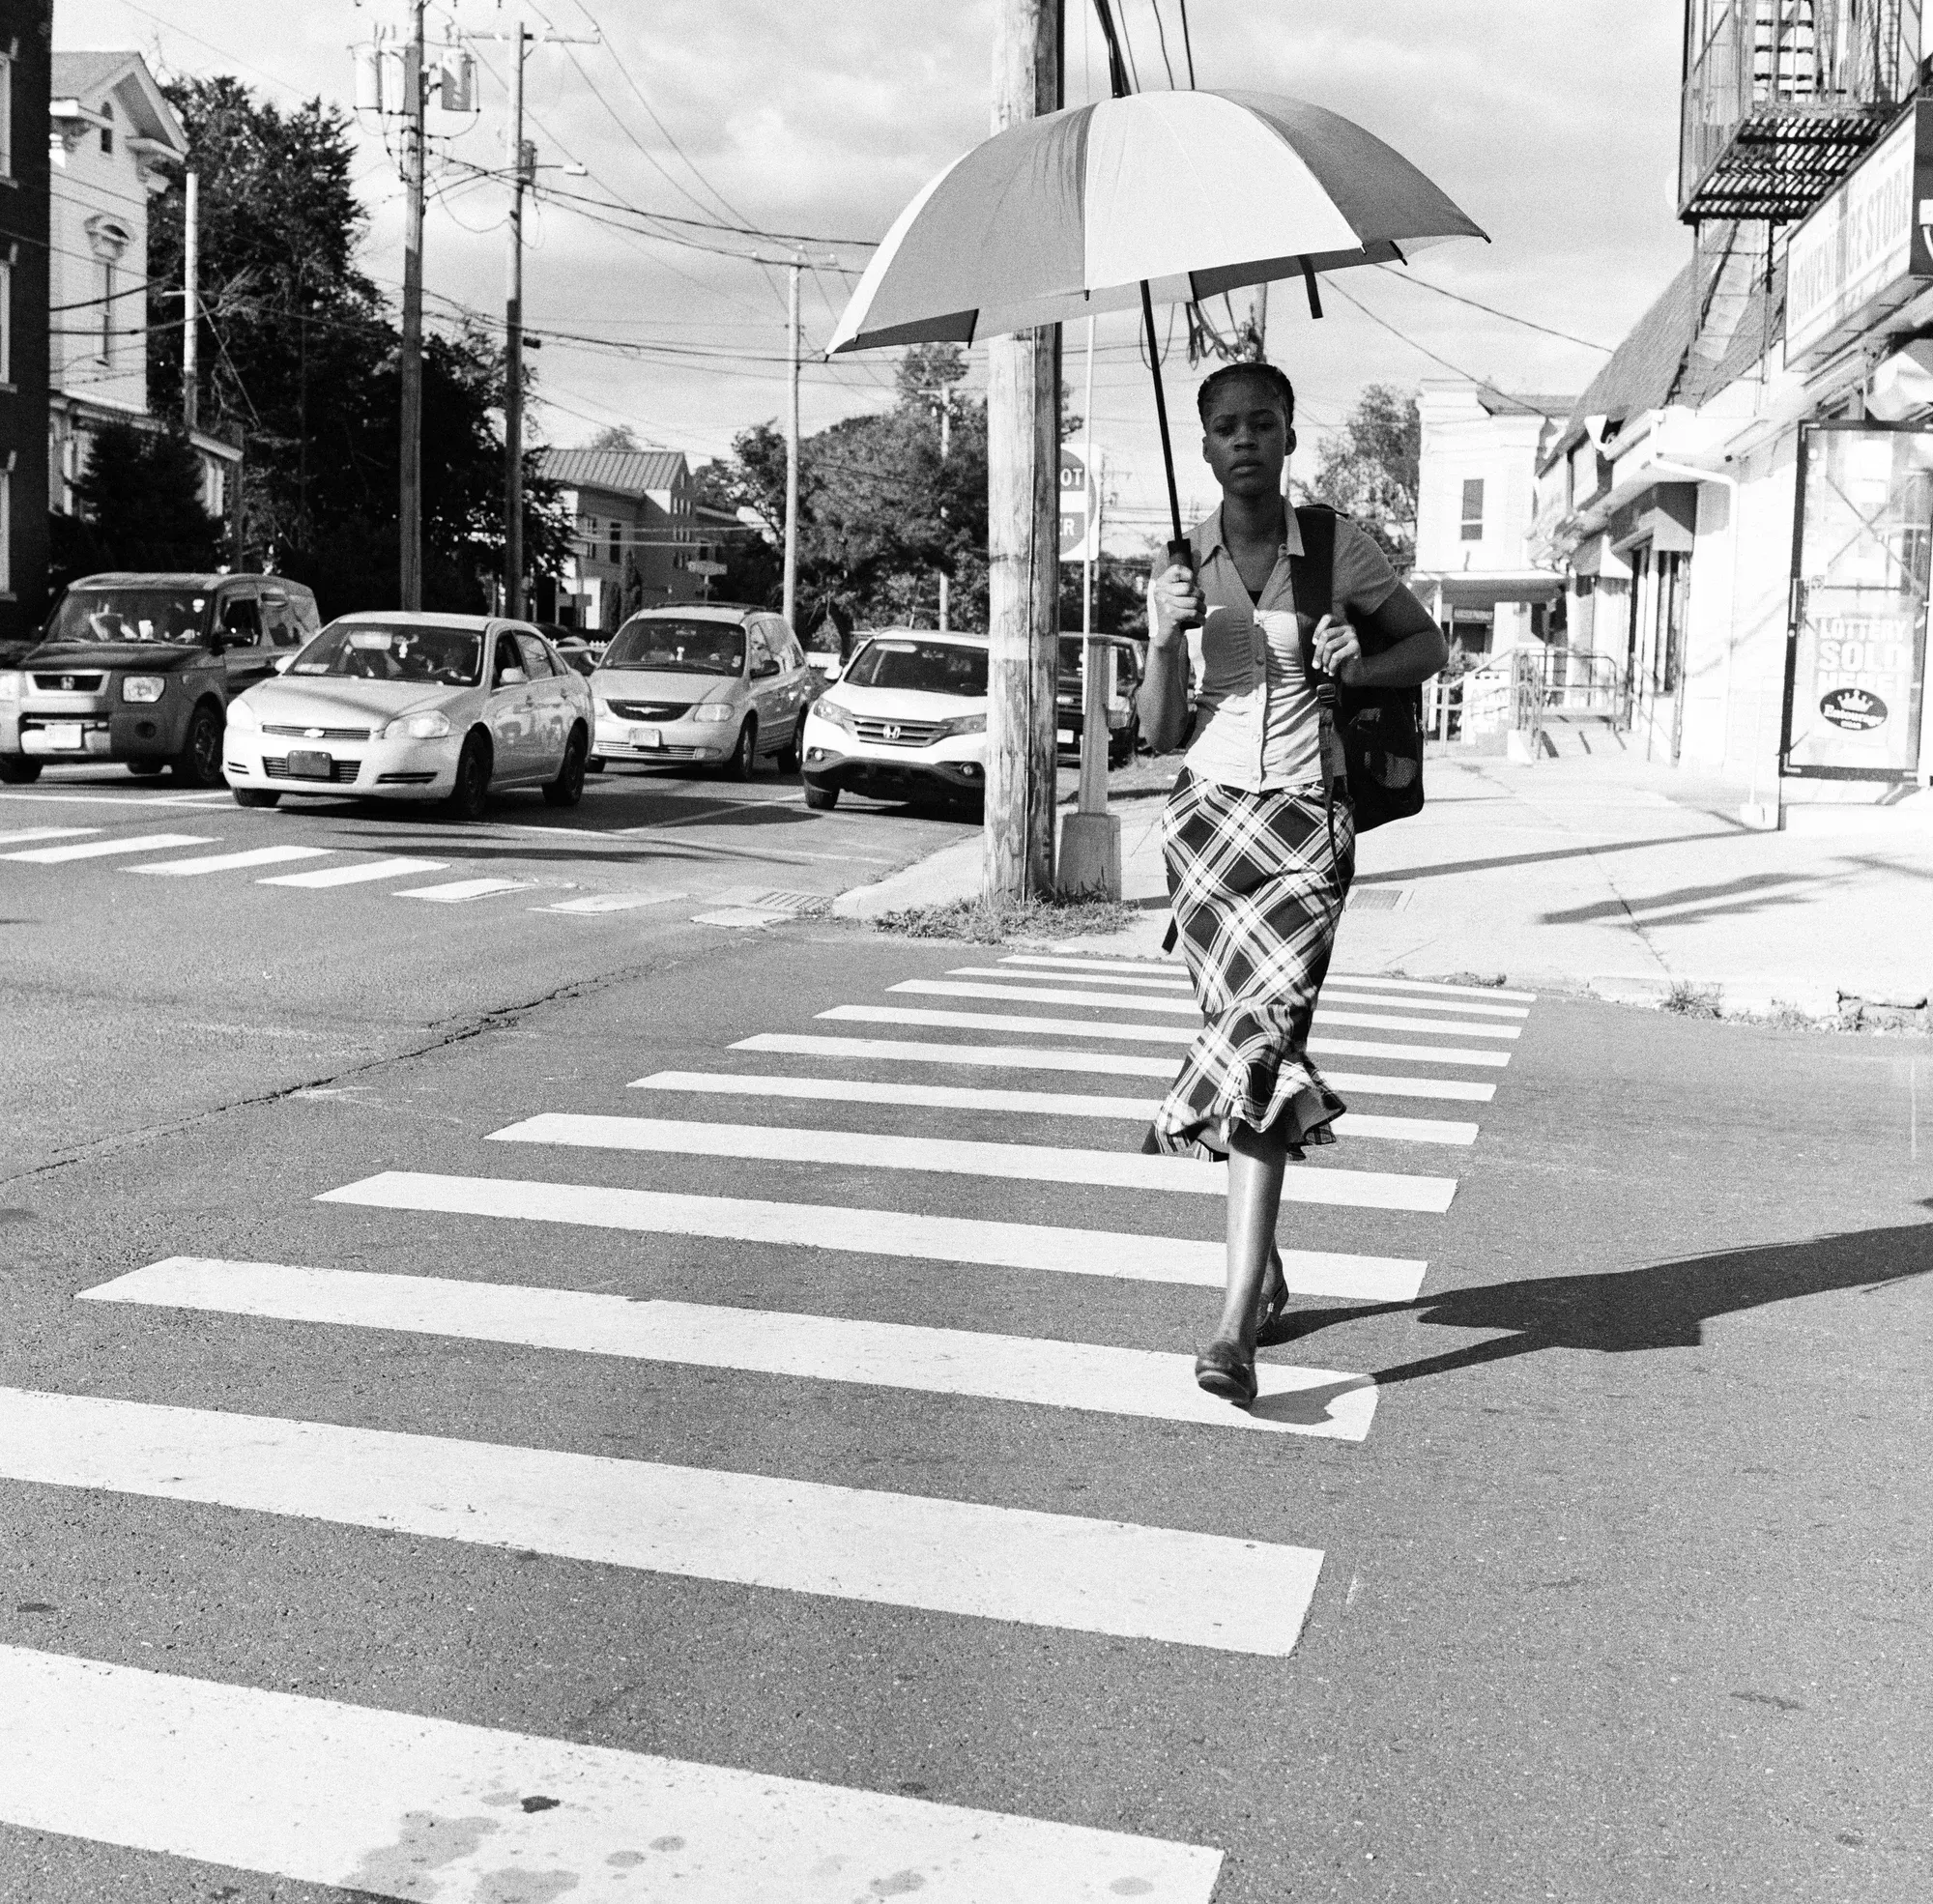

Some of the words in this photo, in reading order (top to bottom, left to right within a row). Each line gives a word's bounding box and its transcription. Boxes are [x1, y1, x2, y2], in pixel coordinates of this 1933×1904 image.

[1865, 159, 1910, 260] STORE
[1060, 468, 1082, 486] OT
[1819, 618, 1908, 640] LOTTERY
[1819, 641, 1907, 672] SOLD
